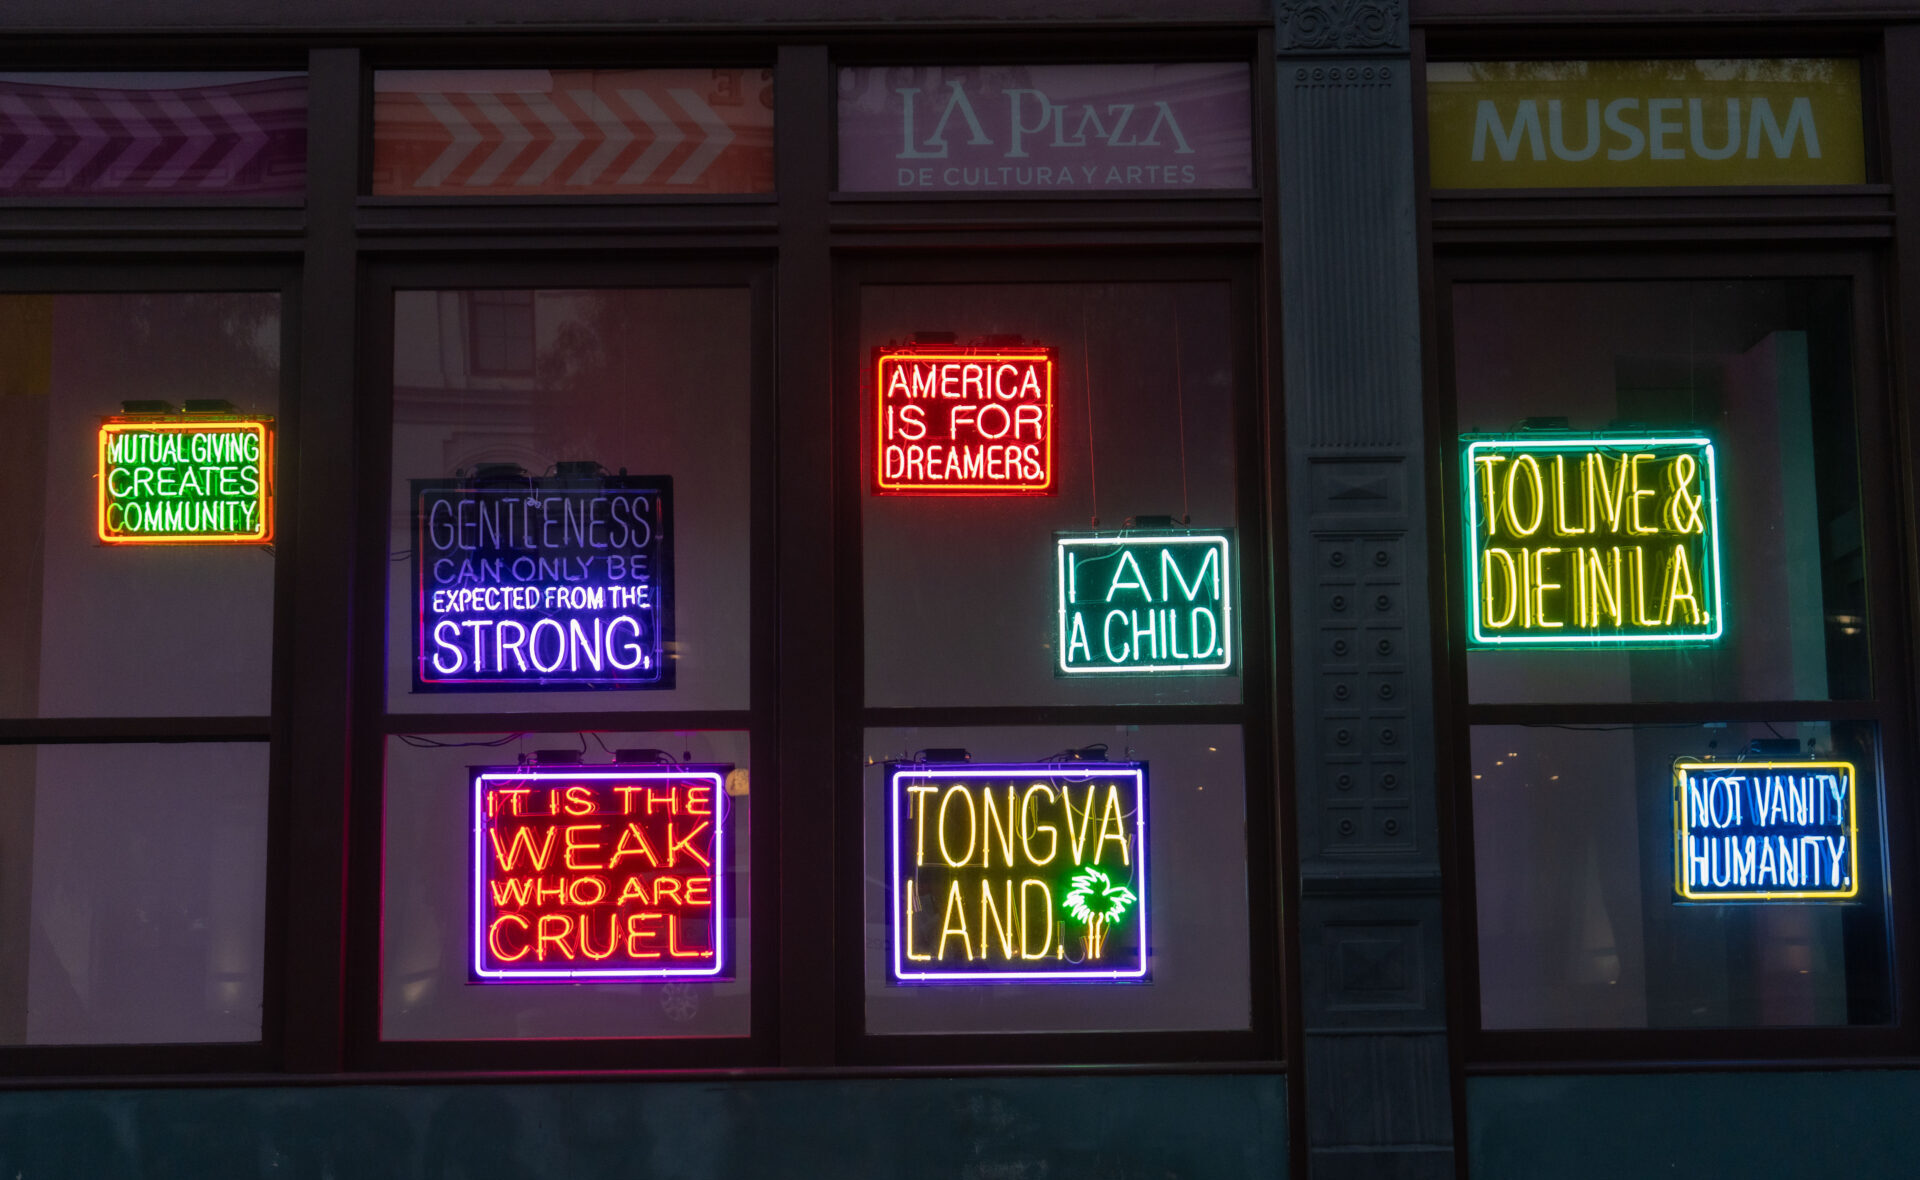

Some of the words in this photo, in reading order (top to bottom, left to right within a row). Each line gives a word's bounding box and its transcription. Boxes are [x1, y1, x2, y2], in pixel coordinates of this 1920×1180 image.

[896, 80, 994, 158] LA
[1471, 97, 1822, 162] MUSEUM
[897, 167, 934, 186] DE
[943, 166, 1075, 186] CULTURA
[1081, 166, 1099, 184] Y
[1104, 165, 1197, 185] ARTES
[887, 364, 1042, 400] AMERICA
[888, 404, 927, 441] IS
[951, 403, 1043, 440] FOR
[107, 433, 190, 464] MUTUAL
[191, 433, 259, 463] GIVING
[886, 444, 1045, 481] DREAMERS.
[108, 465, 260, 498] CREATES
[1474, 454, 1544, 535] TO
[1555, 453, 1659, 534] LIVE
[1671, 453, 1704, 534] &
[429, 496, 651, 550] GENTLENESS
[433, 557, 501, 584] CAN
[511, 555, 594, 582] ONLY
[607, 554, 651, 581] BE
[1068, 551, 1077, 604] I
[1105, 547, 1221, 603] AM
[1484, 546, 1564, 629] DIE
[1577, 545, 1622, 629] IN
[432, 586, 541, 613] EXPECTED
[544, 586, 604, 611] FROM
[607, 584, 652, 609] THE
[1068, 611, 1092, 663] A
[1103, 606, 1224, 664] CHILD.
[487, 788, 531, 818] IT
[550, 786, 592, 816] IS
[613, 786, 712, 816] THE
[906, 784, 1130, 868] TONGVA
[1689, 776, 1746, 829] NOT
[1753, 774, 1848, 828] VANITY
[489, 820, 711, 872] WEAK
[1689, 834, 1850, 888] HUMANITY.
[490, 877, 606, 907] WHO
[617, 876, 712, 906] ARE
[489, 913, 713, 962] CRUEL.
[906, 878, 1064, 961] LAND.
